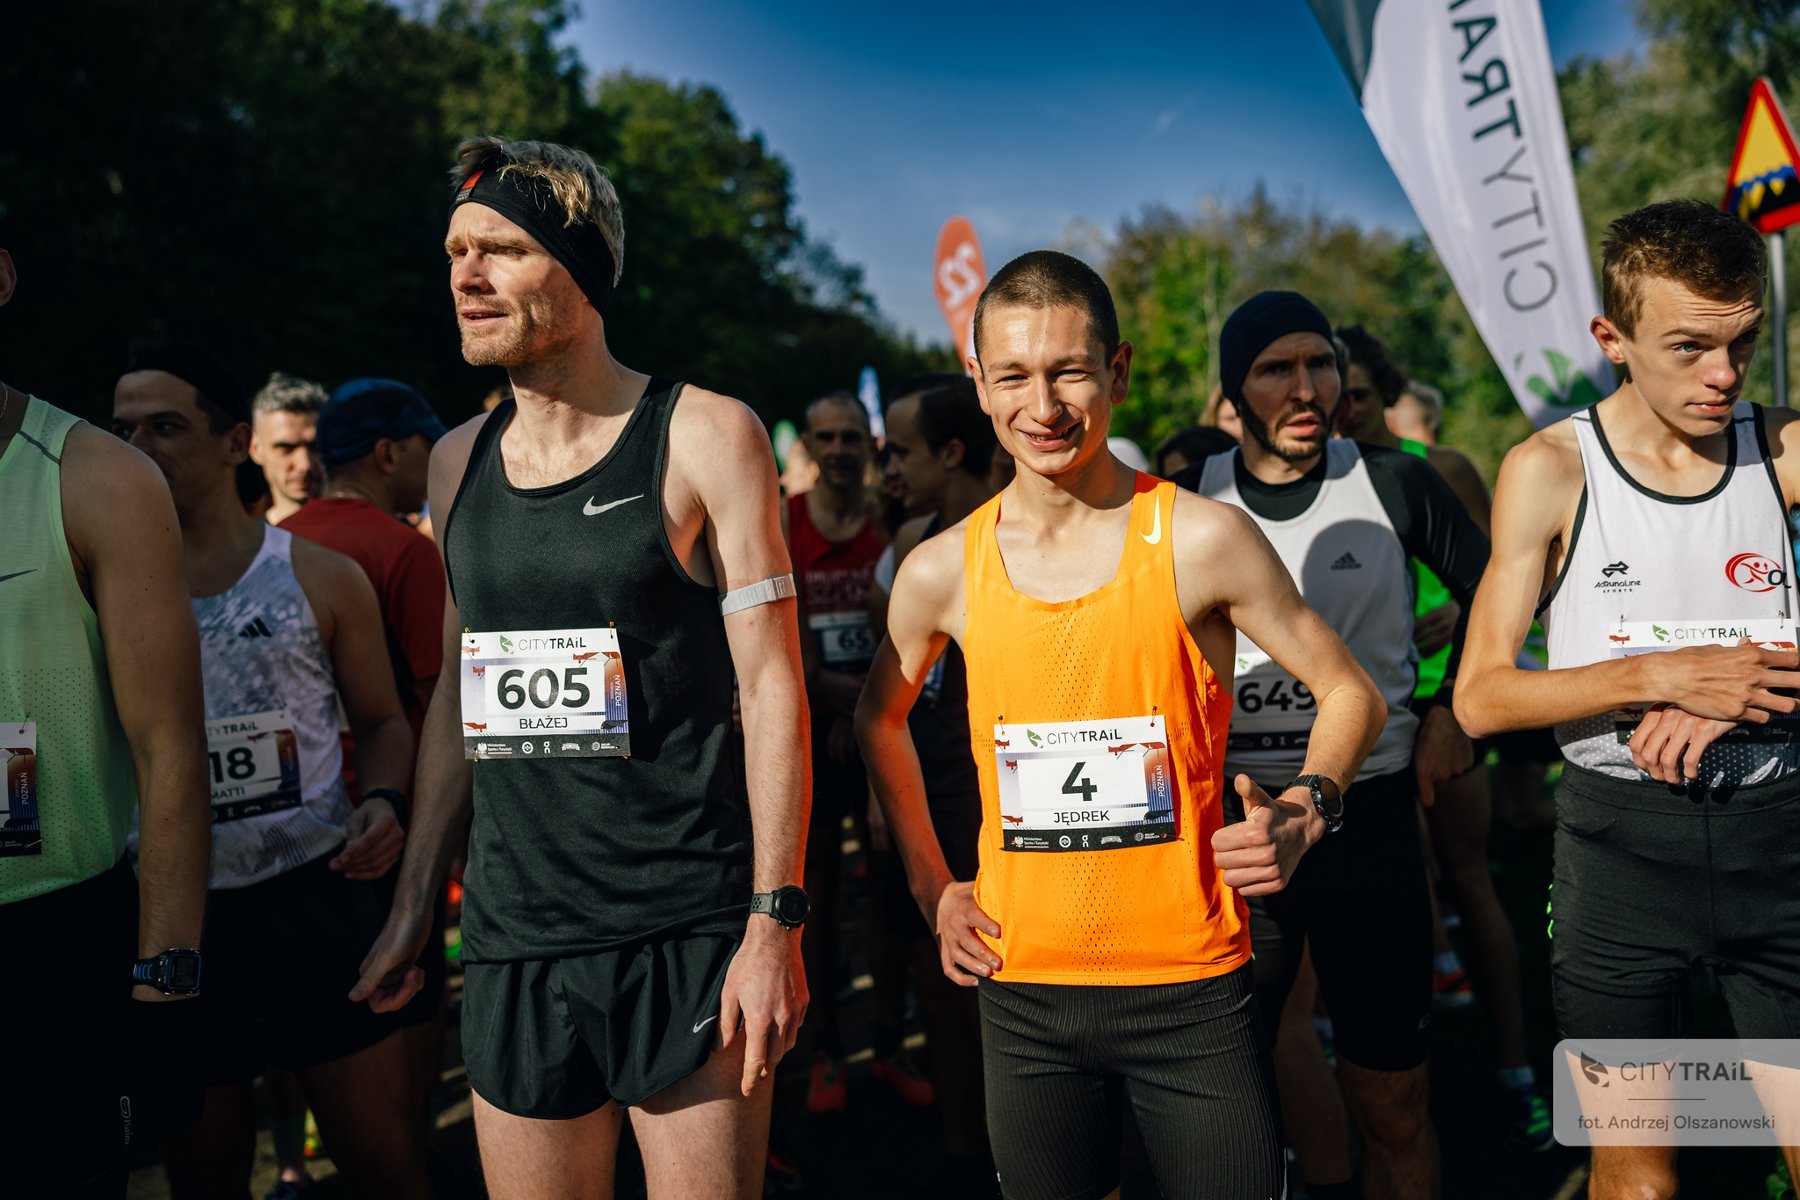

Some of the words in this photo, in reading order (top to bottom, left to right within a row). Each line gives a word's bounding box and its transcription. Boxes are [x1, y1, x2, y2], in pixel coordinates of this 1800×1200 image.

[497, 667, 591, 710] 605
[614, 674, 622, 707] POZNAŃ
[1237, 680, 1317, 714] 649
[206, 721, 259, 737] TYTRAiL
[519, 715, 568, 730] BŁAŻEJ
[208, 747, 257, 784] 18
[1061, 761, 1098, 802] 4
[19, 772, 29, 805] POZNAŃ
[1053, 810, 1111, 826] JĘDREK
